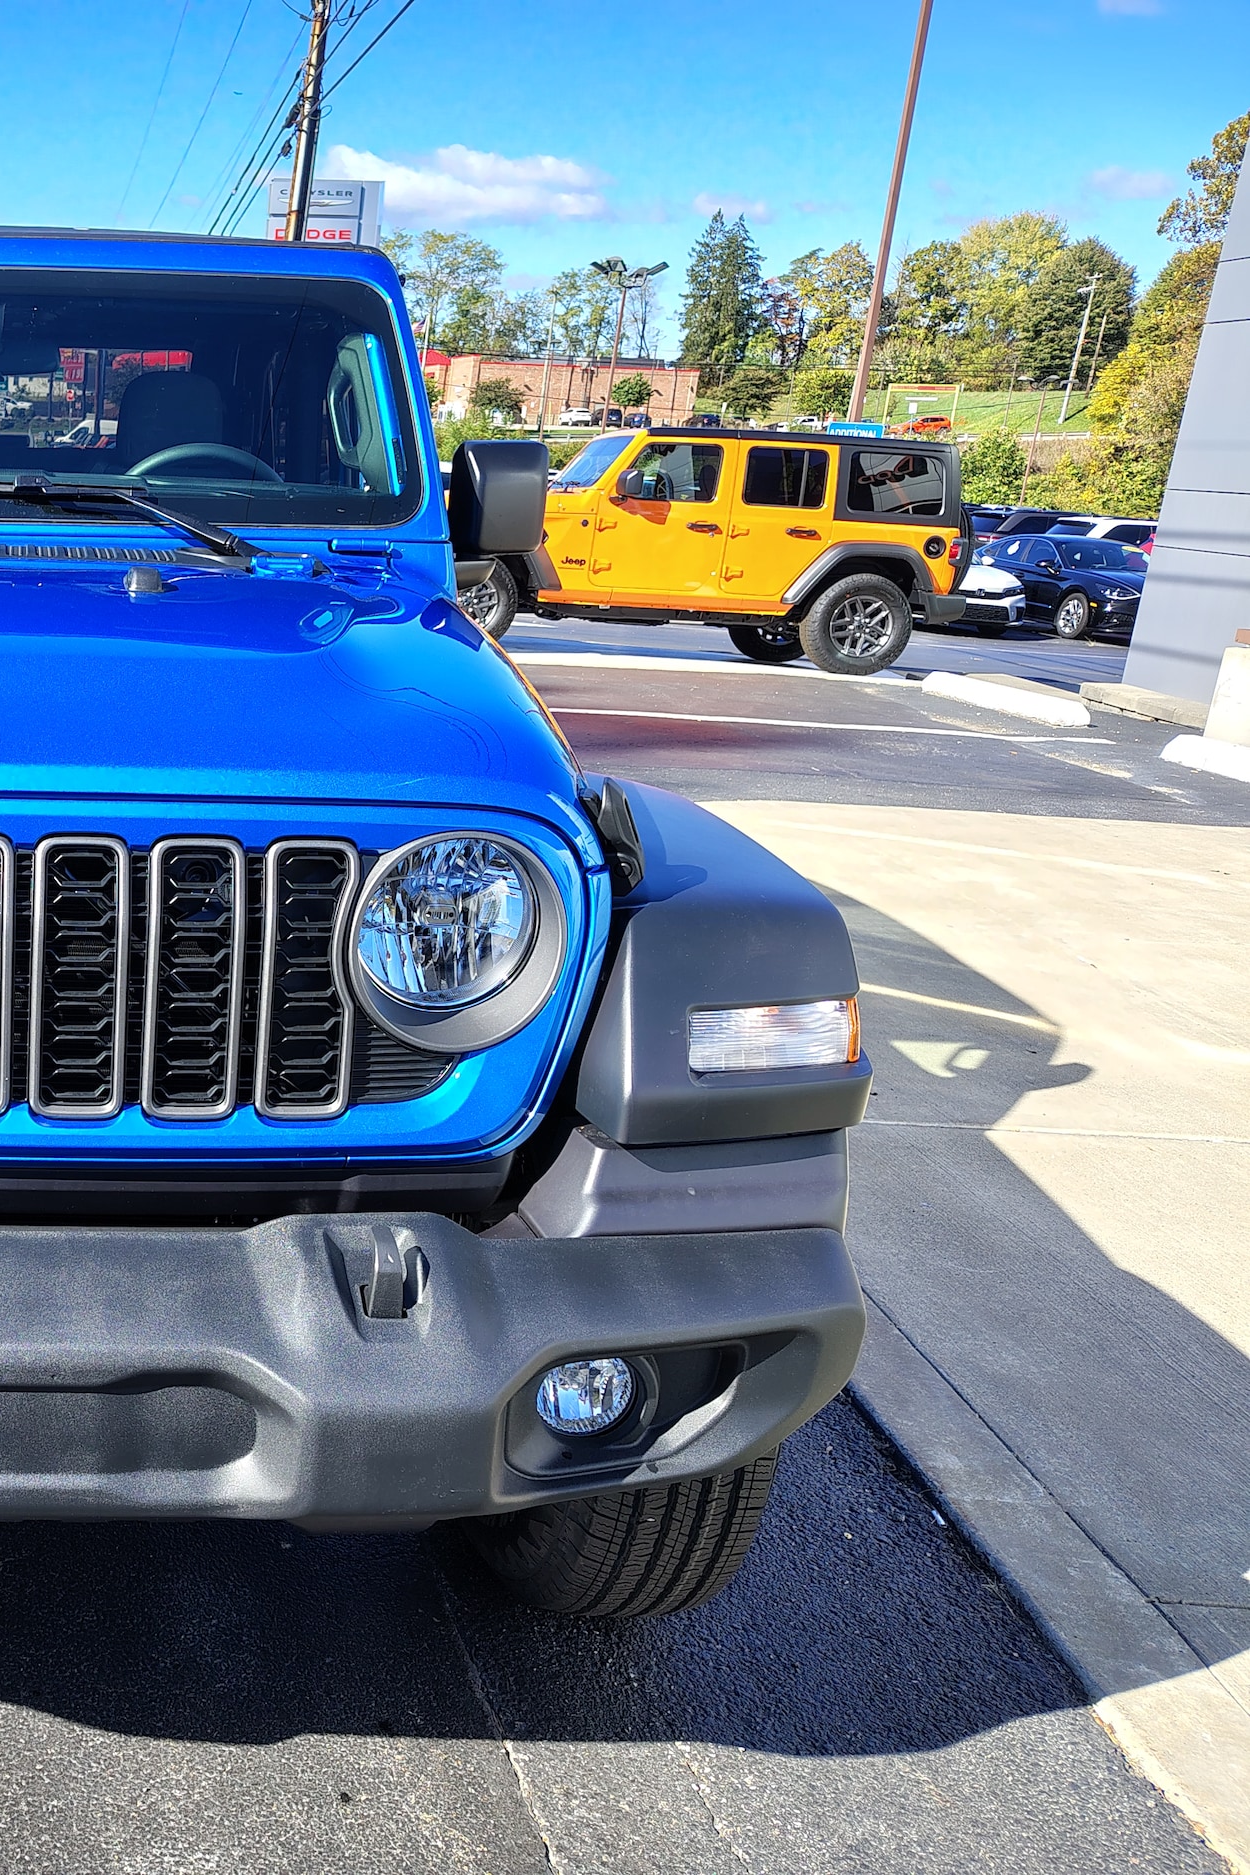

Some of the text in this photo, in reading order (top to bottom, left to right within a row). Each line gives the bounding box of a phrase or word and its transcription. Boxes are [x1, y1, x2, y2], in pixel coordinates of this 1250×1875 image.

[280, 189, 353, 197] CYSLER
[275, 229, 352, 240] DDGE
[829, 428, 877, 438] ADDITIONAL
[561, 555, 587, 566] Jeep
